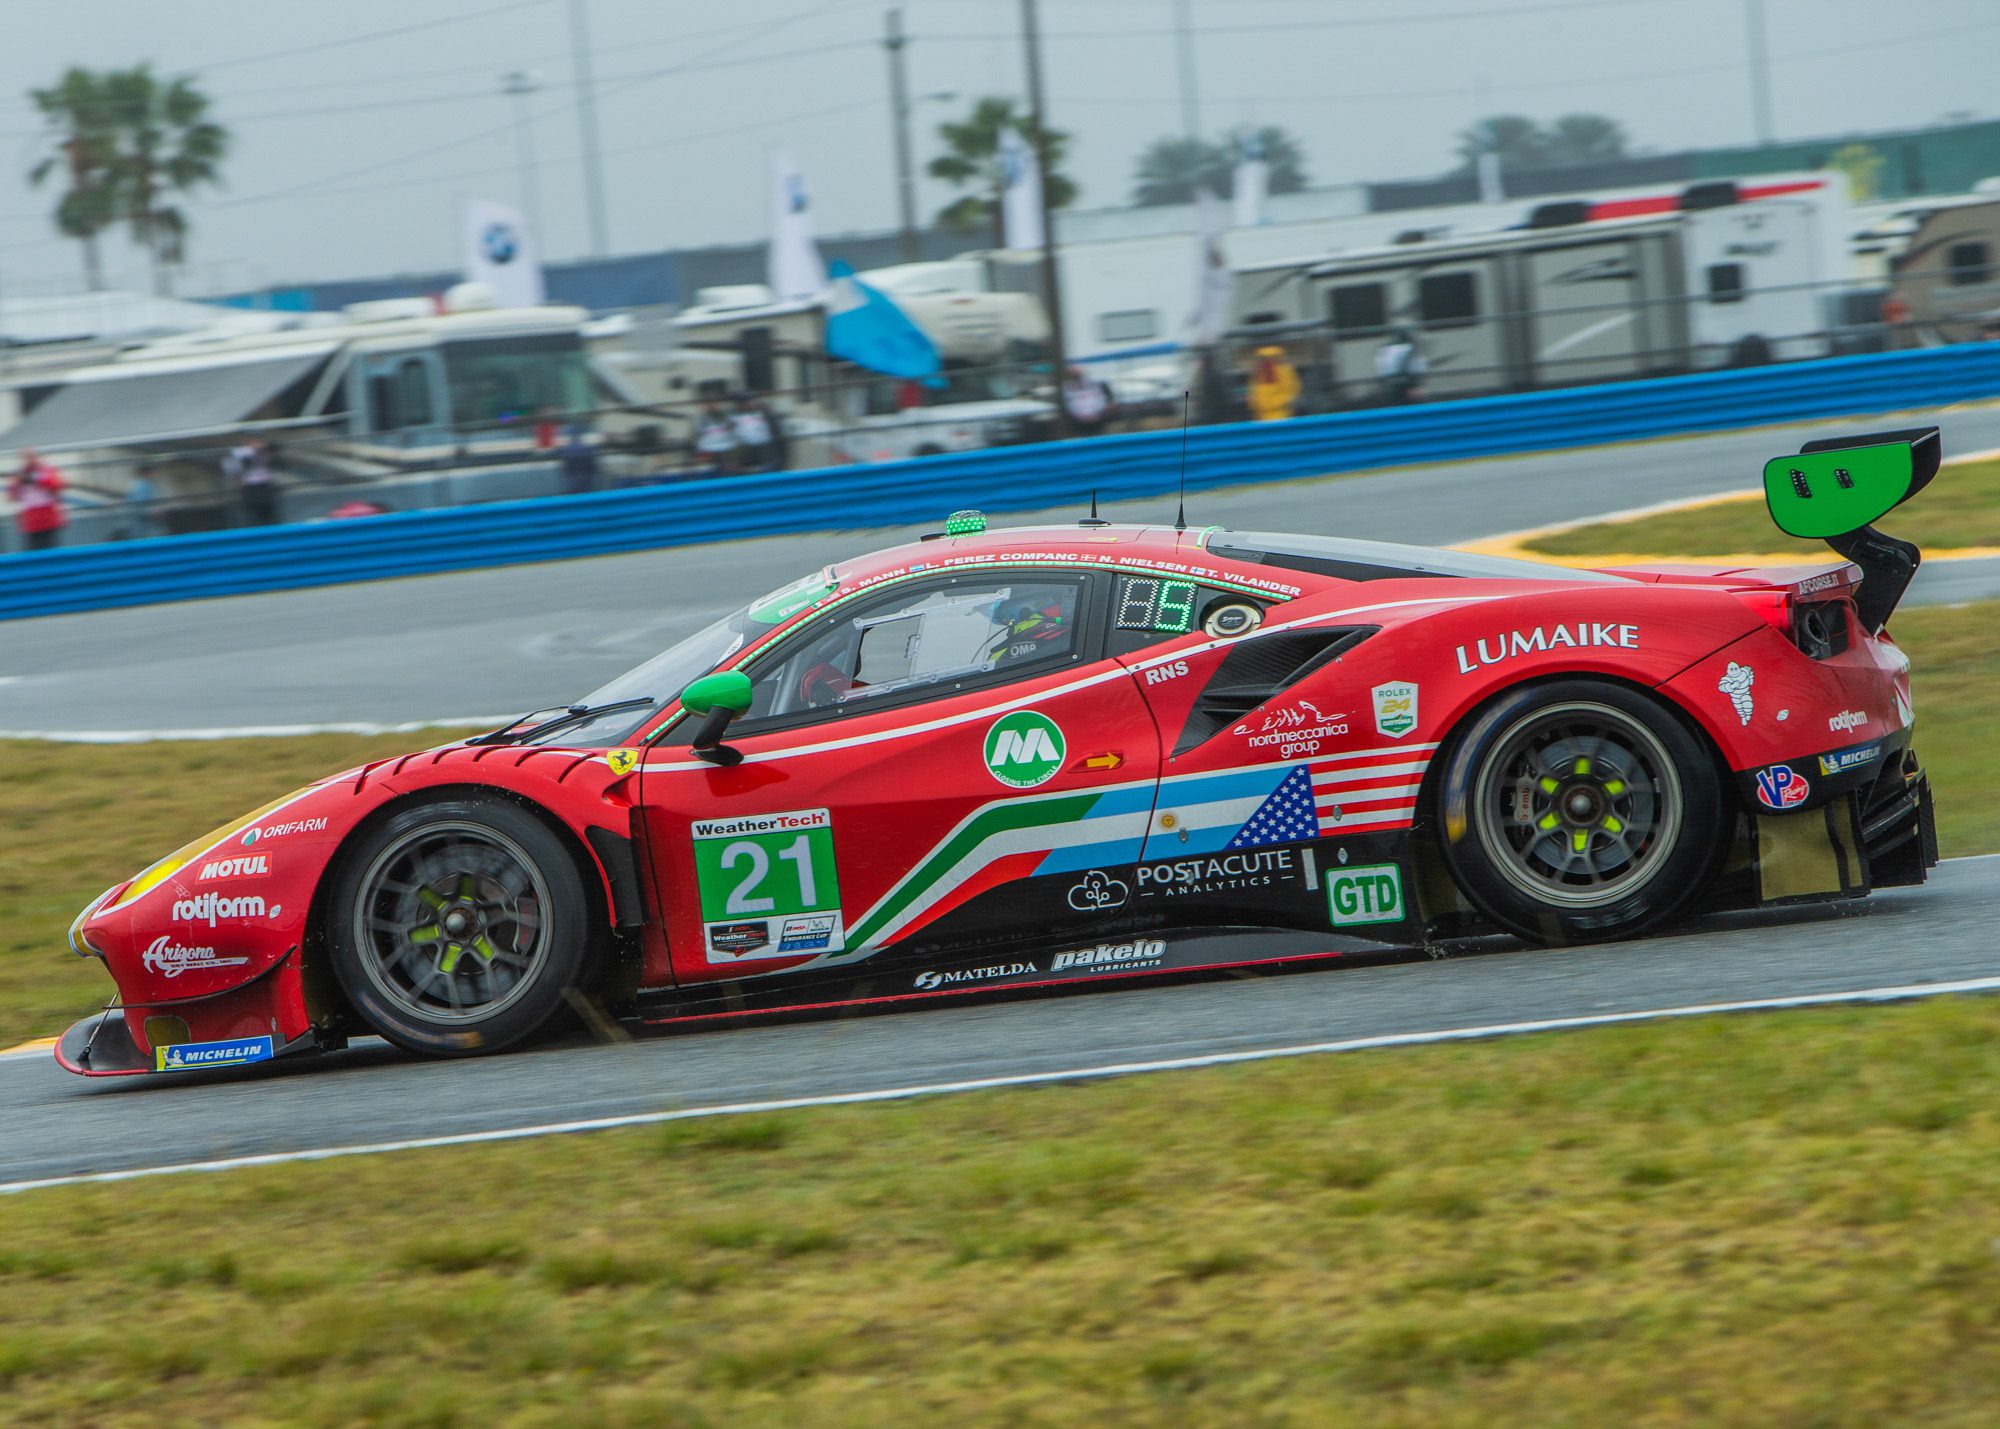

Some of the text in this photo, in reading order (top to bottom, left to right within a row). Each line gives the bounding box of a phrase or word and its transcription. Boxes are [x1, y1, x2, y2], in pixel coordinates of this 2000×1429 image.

[859, 568, 906, 587] MANN
[944, 554, 997, 567] PEREZ
[1000, 552, 1078, 562] COMPANC
[1099, 555, 1115, 564] N.
[1120, 557, 1187, 573] NIELSEN
[1207, 570, 1218, 578] T.
[1224, 572, 1302, 597] VILANDER
[1010, 643, 1037, 657] OMP
[1456, 622, 1640, 675] LUMAIKE
[1145, 660, 1189, 686] RNS
[1378, 687, 1412, 698] ROLEX
[1381, 698, 1411, 714] 24
[1828, 709, 1868, 733] rotiform
[1248, 722, 1348, 748] nordmeccanica
[1280, 738, 1320, 760] group
[1840, 745, 1880, 766] MICHELIN
[993, 765, 1059, 787] CLOSING THE CIRCLE
[1756, 765, 1794, 808] VP
[263, 816, 328, 839] ORIFARM
[199, 855, 268, 881] MOTUL
[720, 834, 817, 915] 21
[1137, 849, 1294, 886] POSTACUTE
[1165, 875, 1271, 897] ANALYTICS
[1332, 873, 1397, 916] GTD
[172, 891, 265, 928] rotiform
[1051, 938, 1167, 972] pakelo
[1090, 958, 1162, 973] LUBRICANTS
[944, 961, 1038, 983] MATELDA
[185, 1045, 262, 1062] MICHELIN
